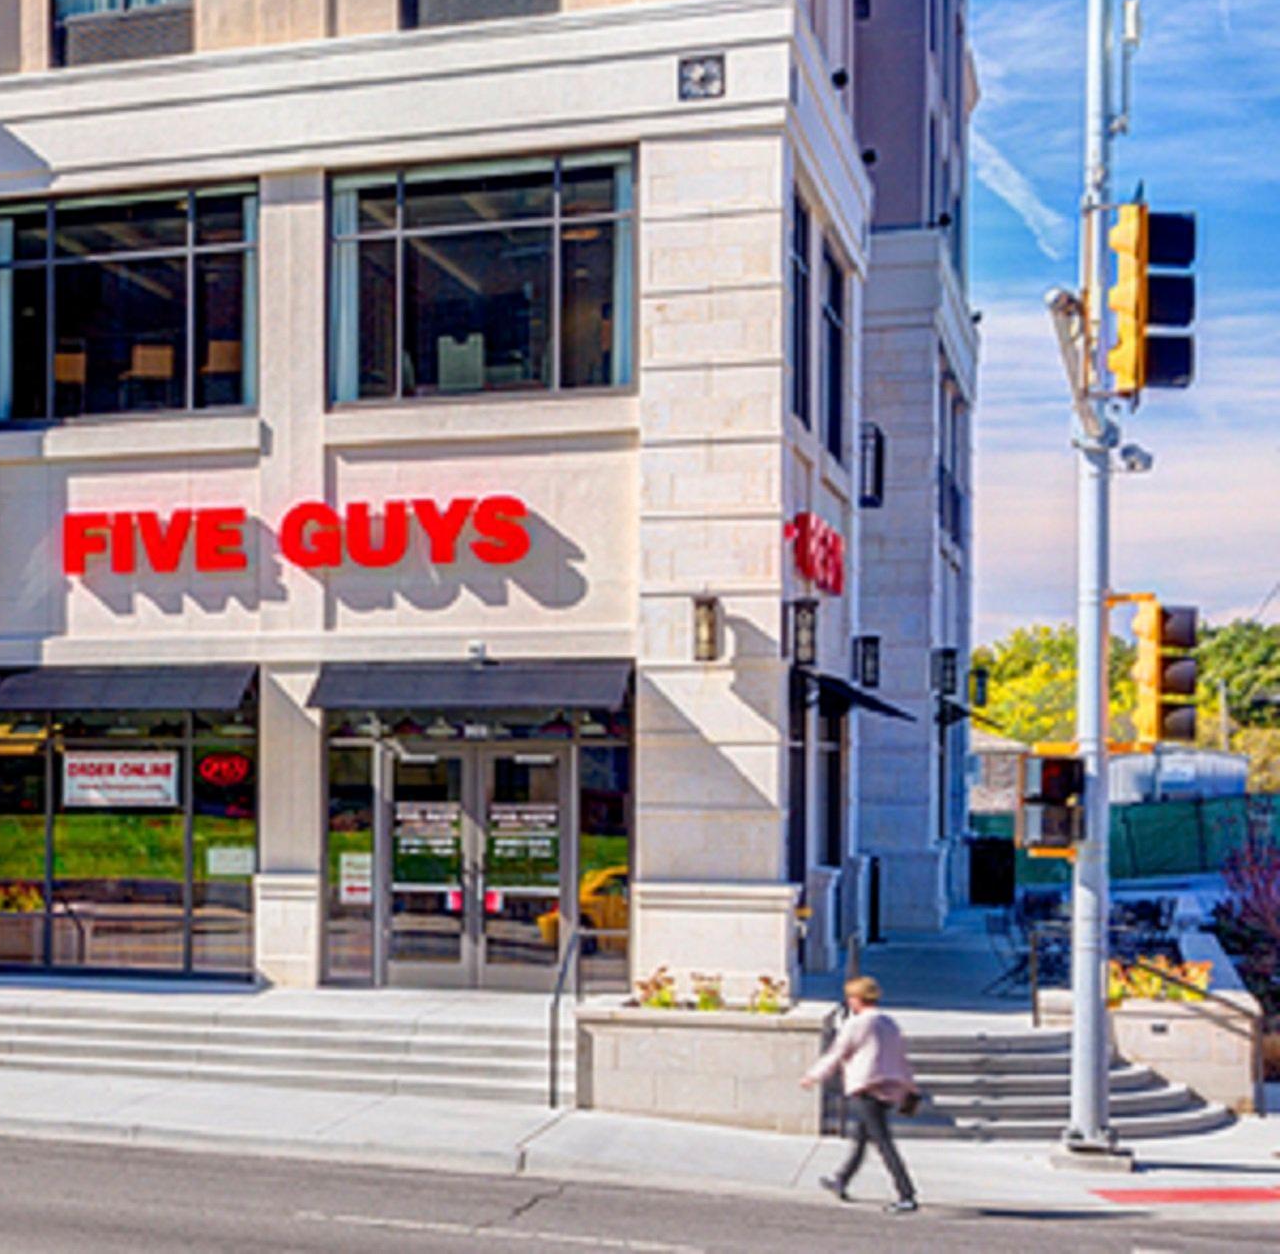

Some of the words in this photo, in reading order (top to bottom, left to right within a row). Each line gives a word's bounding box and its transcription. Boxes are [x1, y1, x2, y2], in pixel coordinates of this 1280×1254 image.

[63, 508, 248, 576] FIVE
[277, 495, 531, 569] GUYS
[67, 762, 116, 778] ORDER
[120, 762, 172, 778] ONLINE
